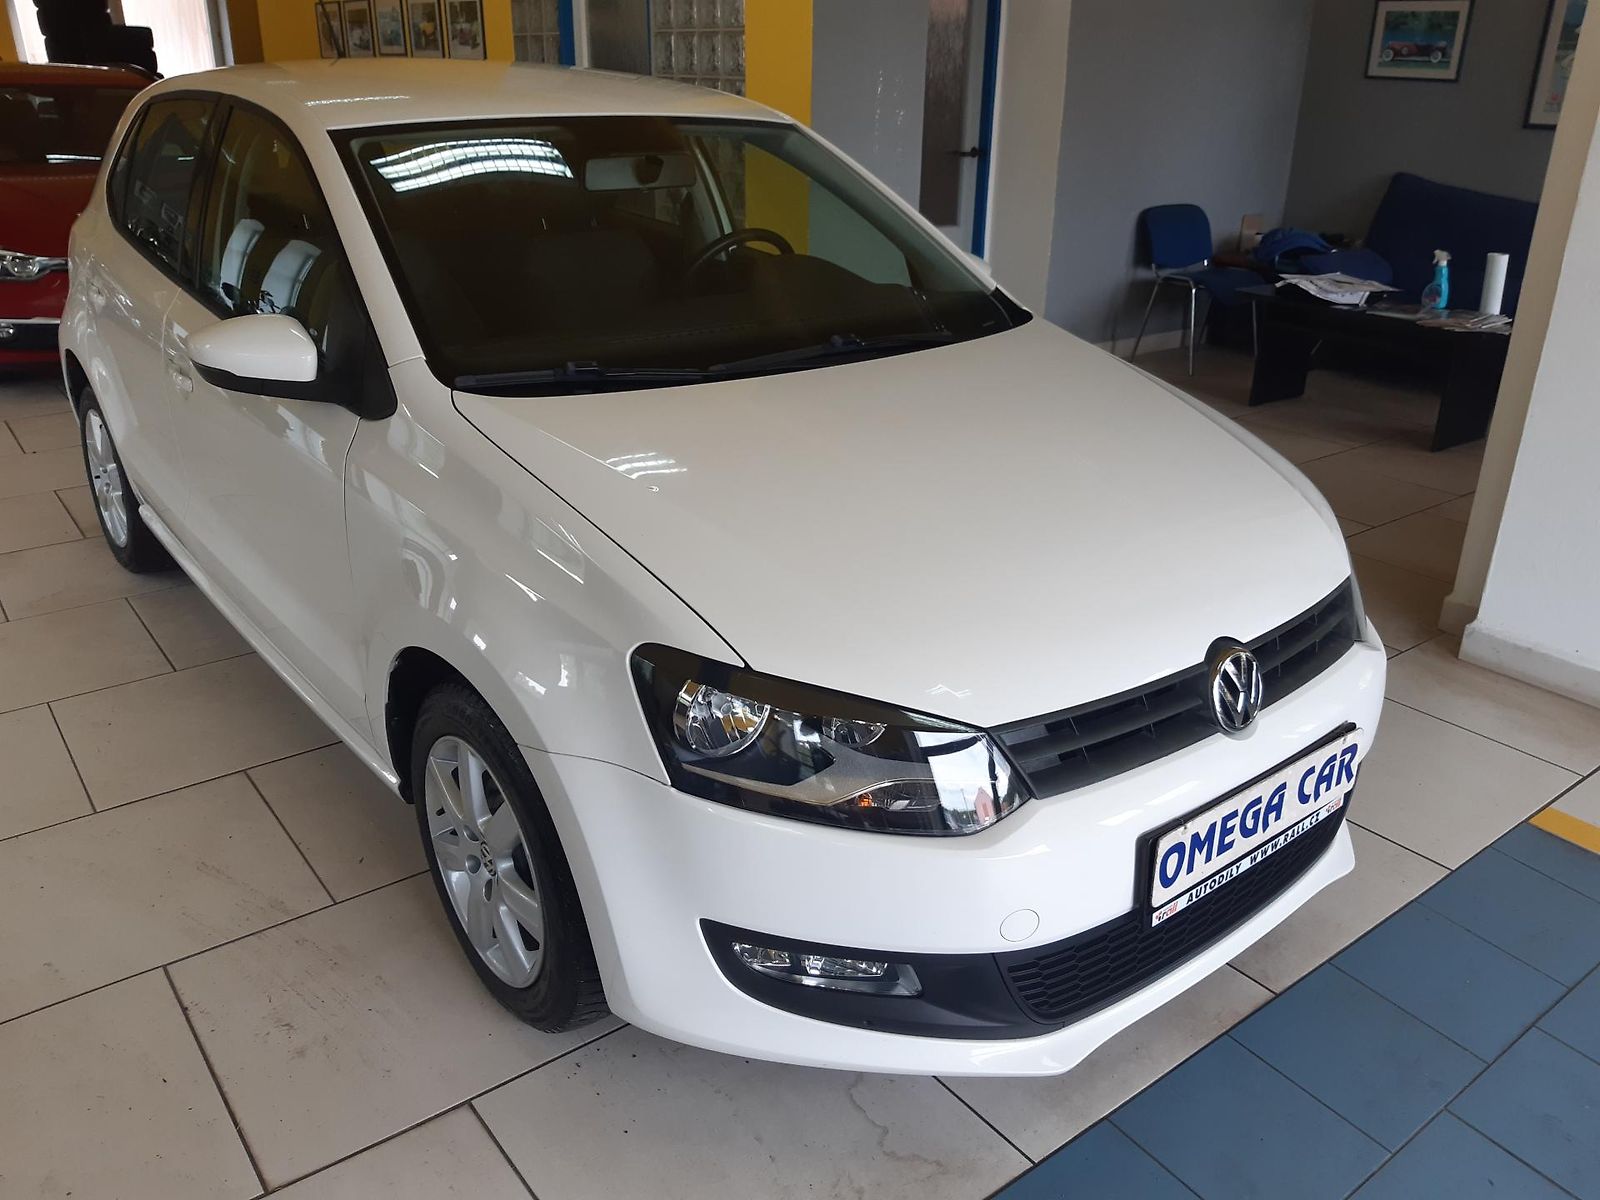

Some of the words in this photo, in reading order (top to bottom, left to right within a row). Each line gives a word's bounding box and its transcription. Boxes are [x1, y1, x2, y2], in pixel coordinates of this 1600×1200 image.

[1159, 781, 1287, 889] OMEGA
[1297, 742, 1359, 805] CAR
[1186, 863, 1242, 905] AUTODILY
[1249, 811, 1321, 866] WWW.RALL.CZ
